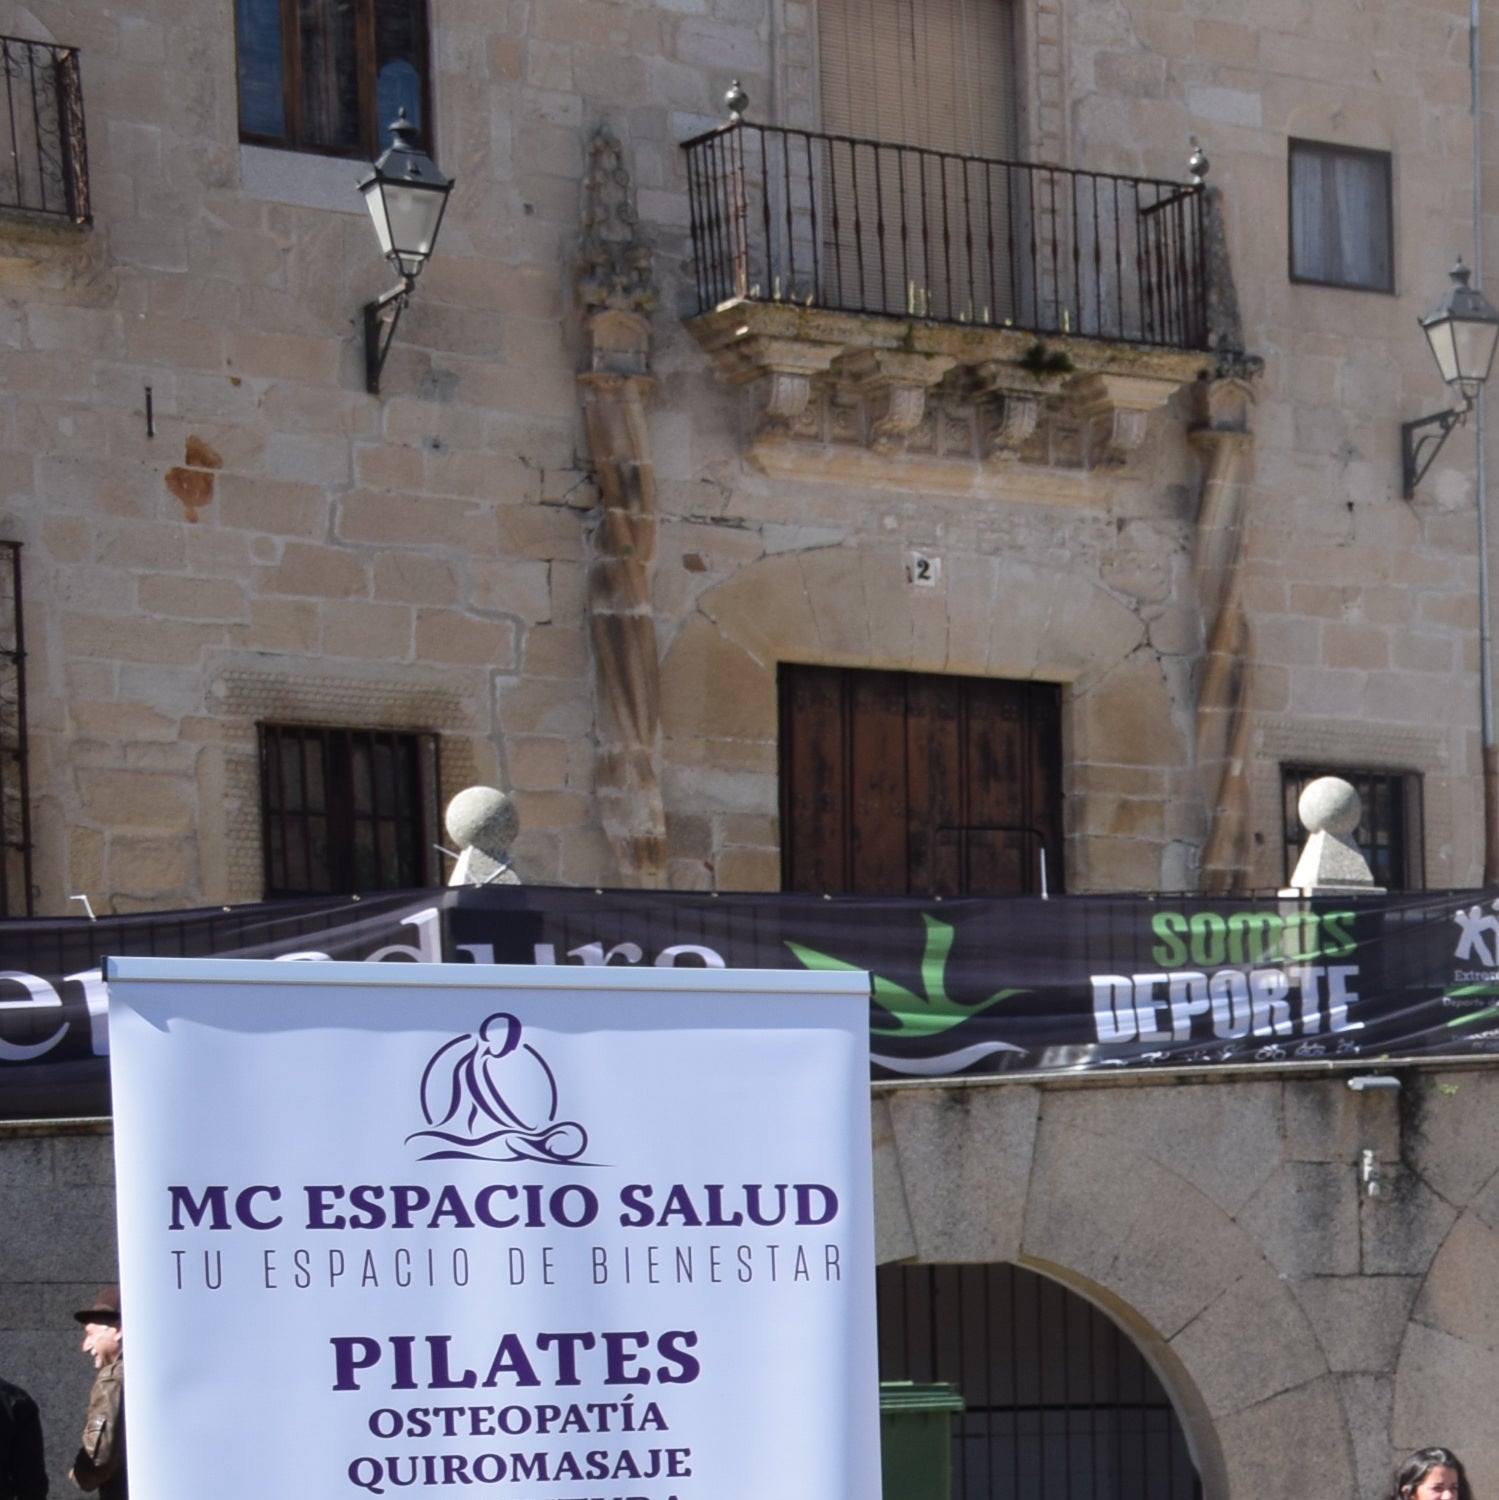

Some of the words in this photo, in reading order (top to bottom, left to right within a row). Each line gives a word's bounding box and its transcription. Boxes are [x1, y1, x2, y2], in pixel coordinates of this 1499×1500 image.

[1090, 965, 1366, 1044] DEPORTE
[168, 1184, 283, 1231] MC
[305, 1183, 599, 1230] ESPACIO
[619, 1182, 840, 1228] SALUD
[171, 1249, 223, 1290] TU
[264, 1246, 470, 1289] ESPACIO
[508, 1246, 555, 1286] DE
[591, 1243, 842, 1285] BIENESTAR
[329, 1330, 701, 1391] PILATES
[367, 1394, 669, 1439] OSTEOPATÍA
[347, 1447, 692, 1494] QUIROMASAJE
